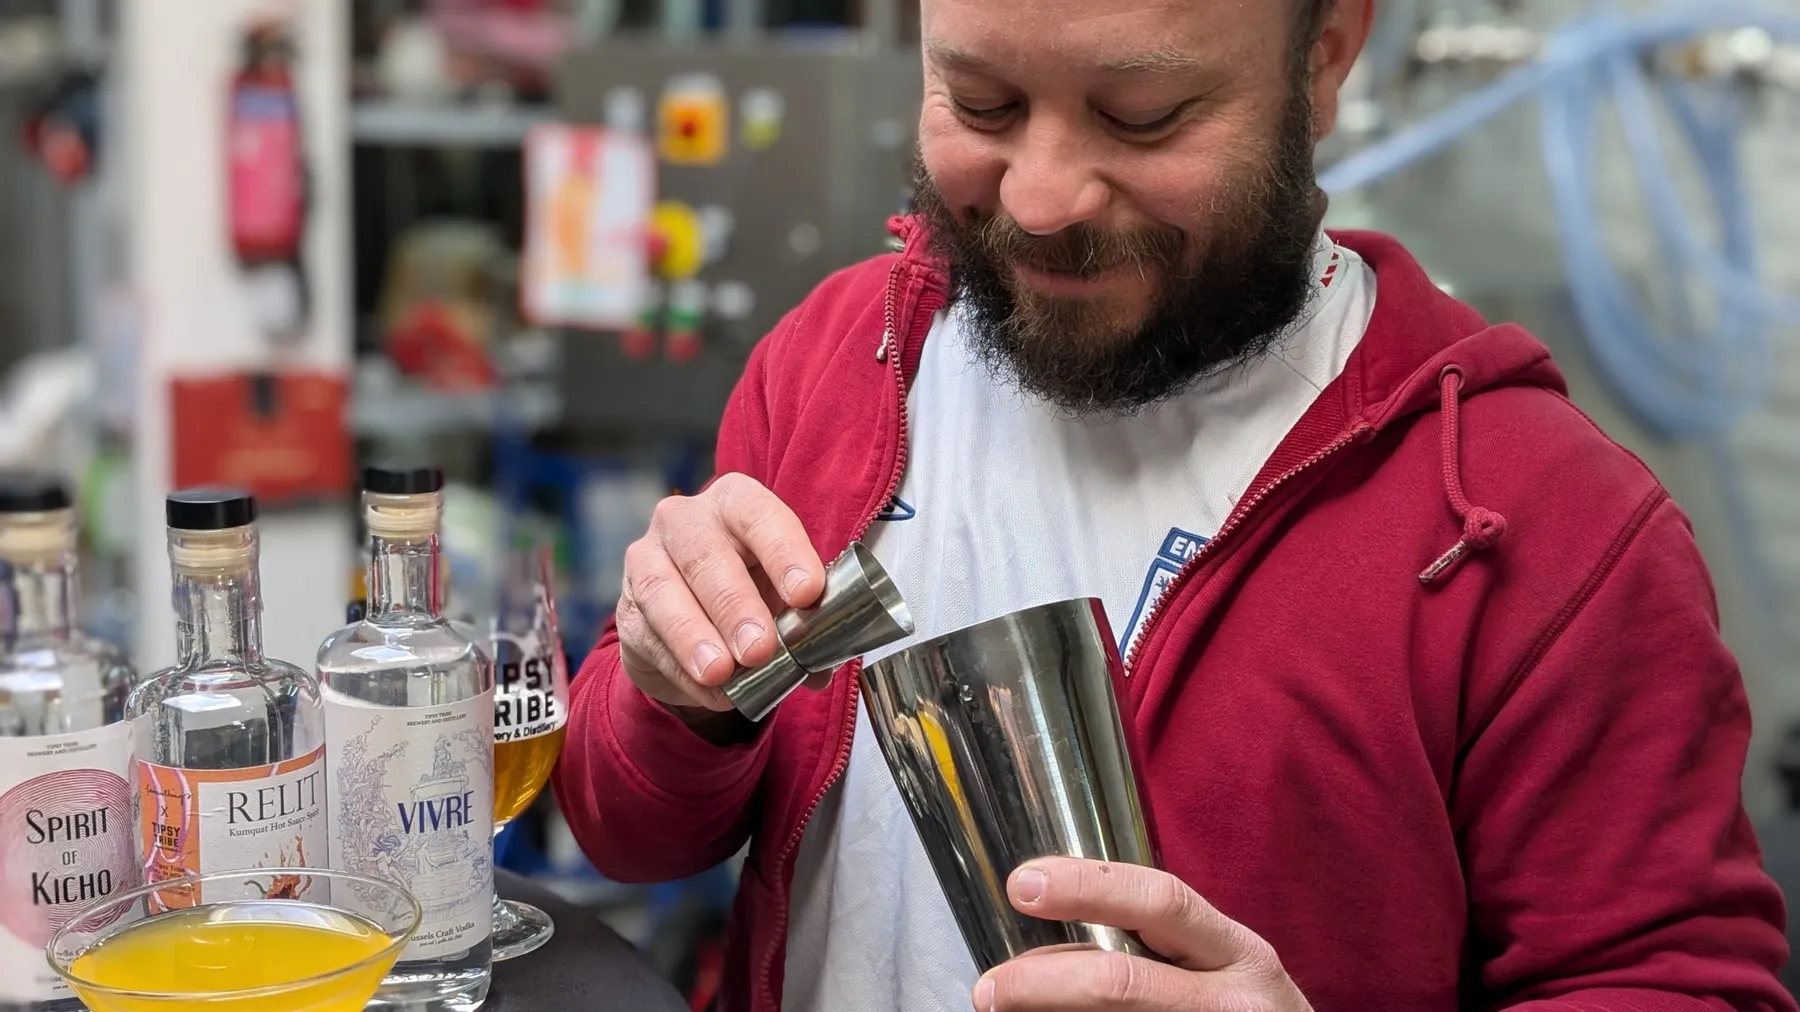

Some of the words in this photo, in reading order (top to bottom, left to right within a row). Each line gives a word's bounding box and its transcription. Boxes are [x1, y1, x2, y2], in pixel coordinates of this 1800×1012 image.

[494, 654, 554, 694] PSY
[494, 690, 555, 727] RIBE
[514, 728, 521, 738] &
[524, 721, 556, 737] Distillery
[227, 769, 319, 824] RELIT
[229, 826, 268, 837] Kumquat
[270, 821, 286, 831] Hot
[287, 816, 306, 827] Sauce
[306, 808, 320, 821] Spirit
[397, 790, 474, 835] VIVRE
[151, 822, 181, 837] TIPSY
[153, 834, 179, 848] TRIBE
[62, 851, 78, 866] OF
[411, 931, 435, 942] ussels
[435, 927, 454, 938] Craft
[455, 921, 475, 933] Vodka
